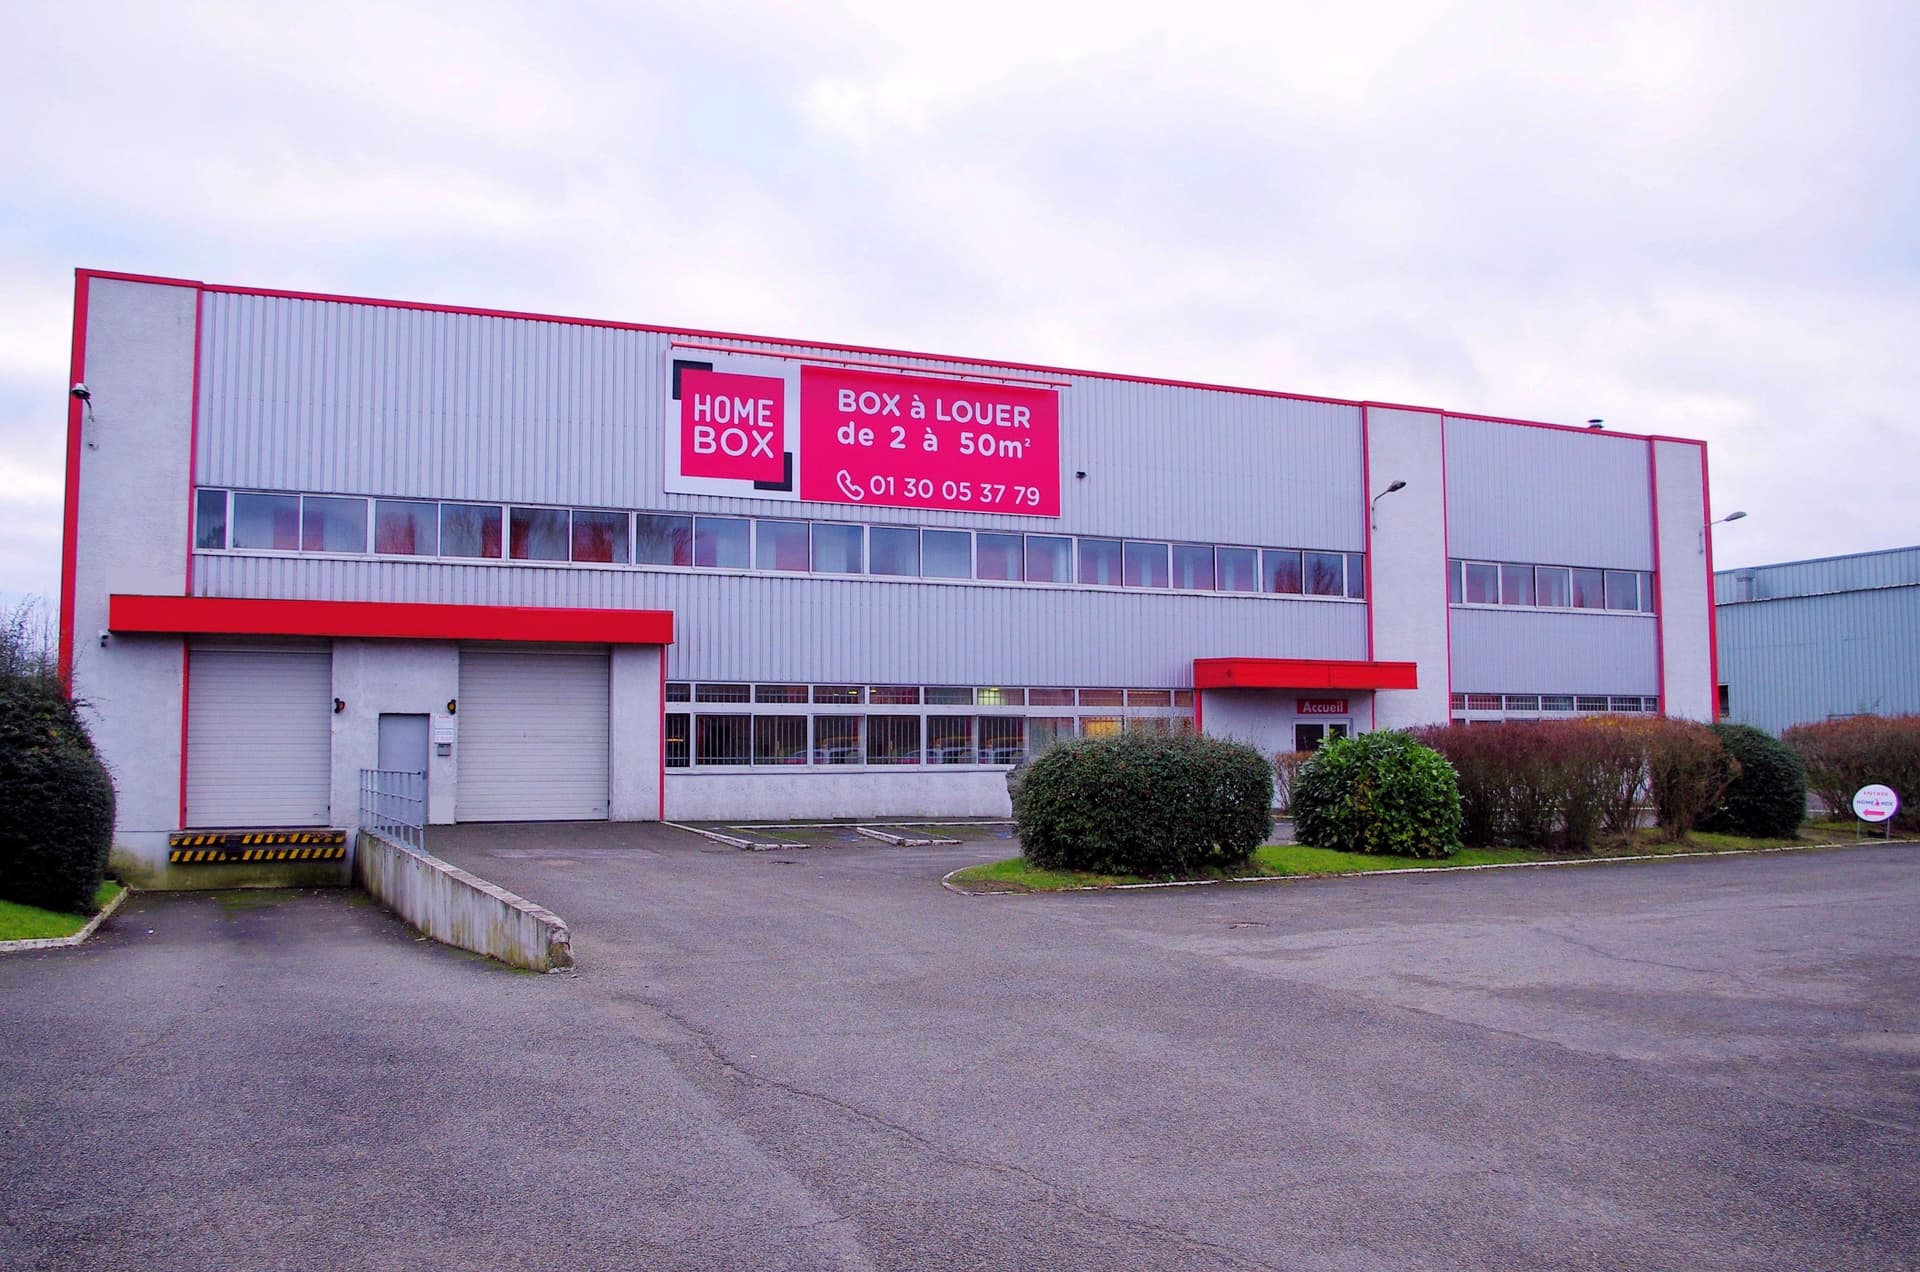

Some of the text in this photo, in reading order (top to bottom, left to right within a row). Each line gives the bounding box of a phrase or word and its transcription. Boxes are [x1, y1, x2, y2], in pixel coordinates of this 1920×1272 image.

[694, 393, 774, 428] HOME
[838, 389, 1031, 429] BOX à LOUER
[694, 425, 774, 459] BOX
[837, 420, 875, 447] de
[889, 425, 906, 449] 2
[922, 426, 938, 452] à
[870, 475, 1040, 506] 01 30 05 37 79
[1303, 701, 1344, 713] Accueil
